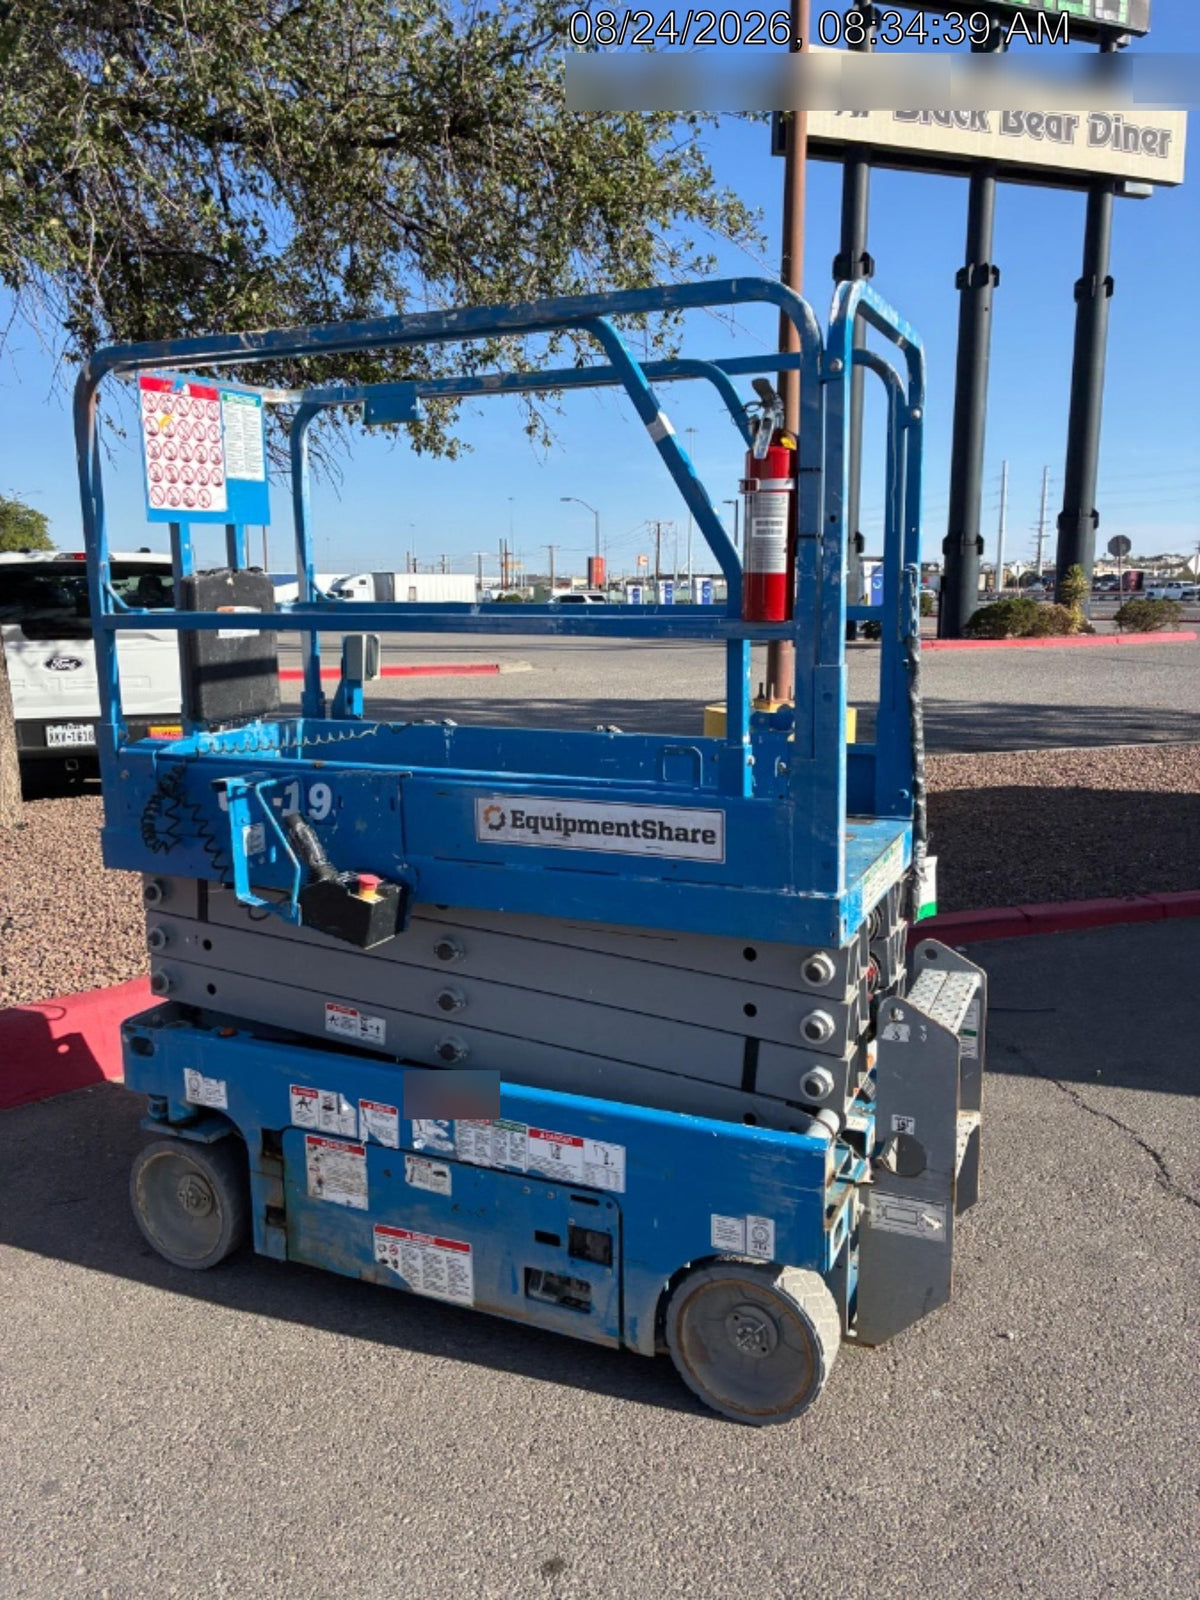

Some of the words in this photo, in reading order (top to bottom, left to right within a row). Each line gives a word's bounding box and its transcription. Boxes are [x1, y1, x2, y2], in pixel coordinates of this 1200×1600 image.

[1000, 111, 1080, 144] Bear
[1087, 111, 1172, 158] Diner
[50, 657, 79, 671] Ford
[510, 809, 716, 845] EquipmentShare
